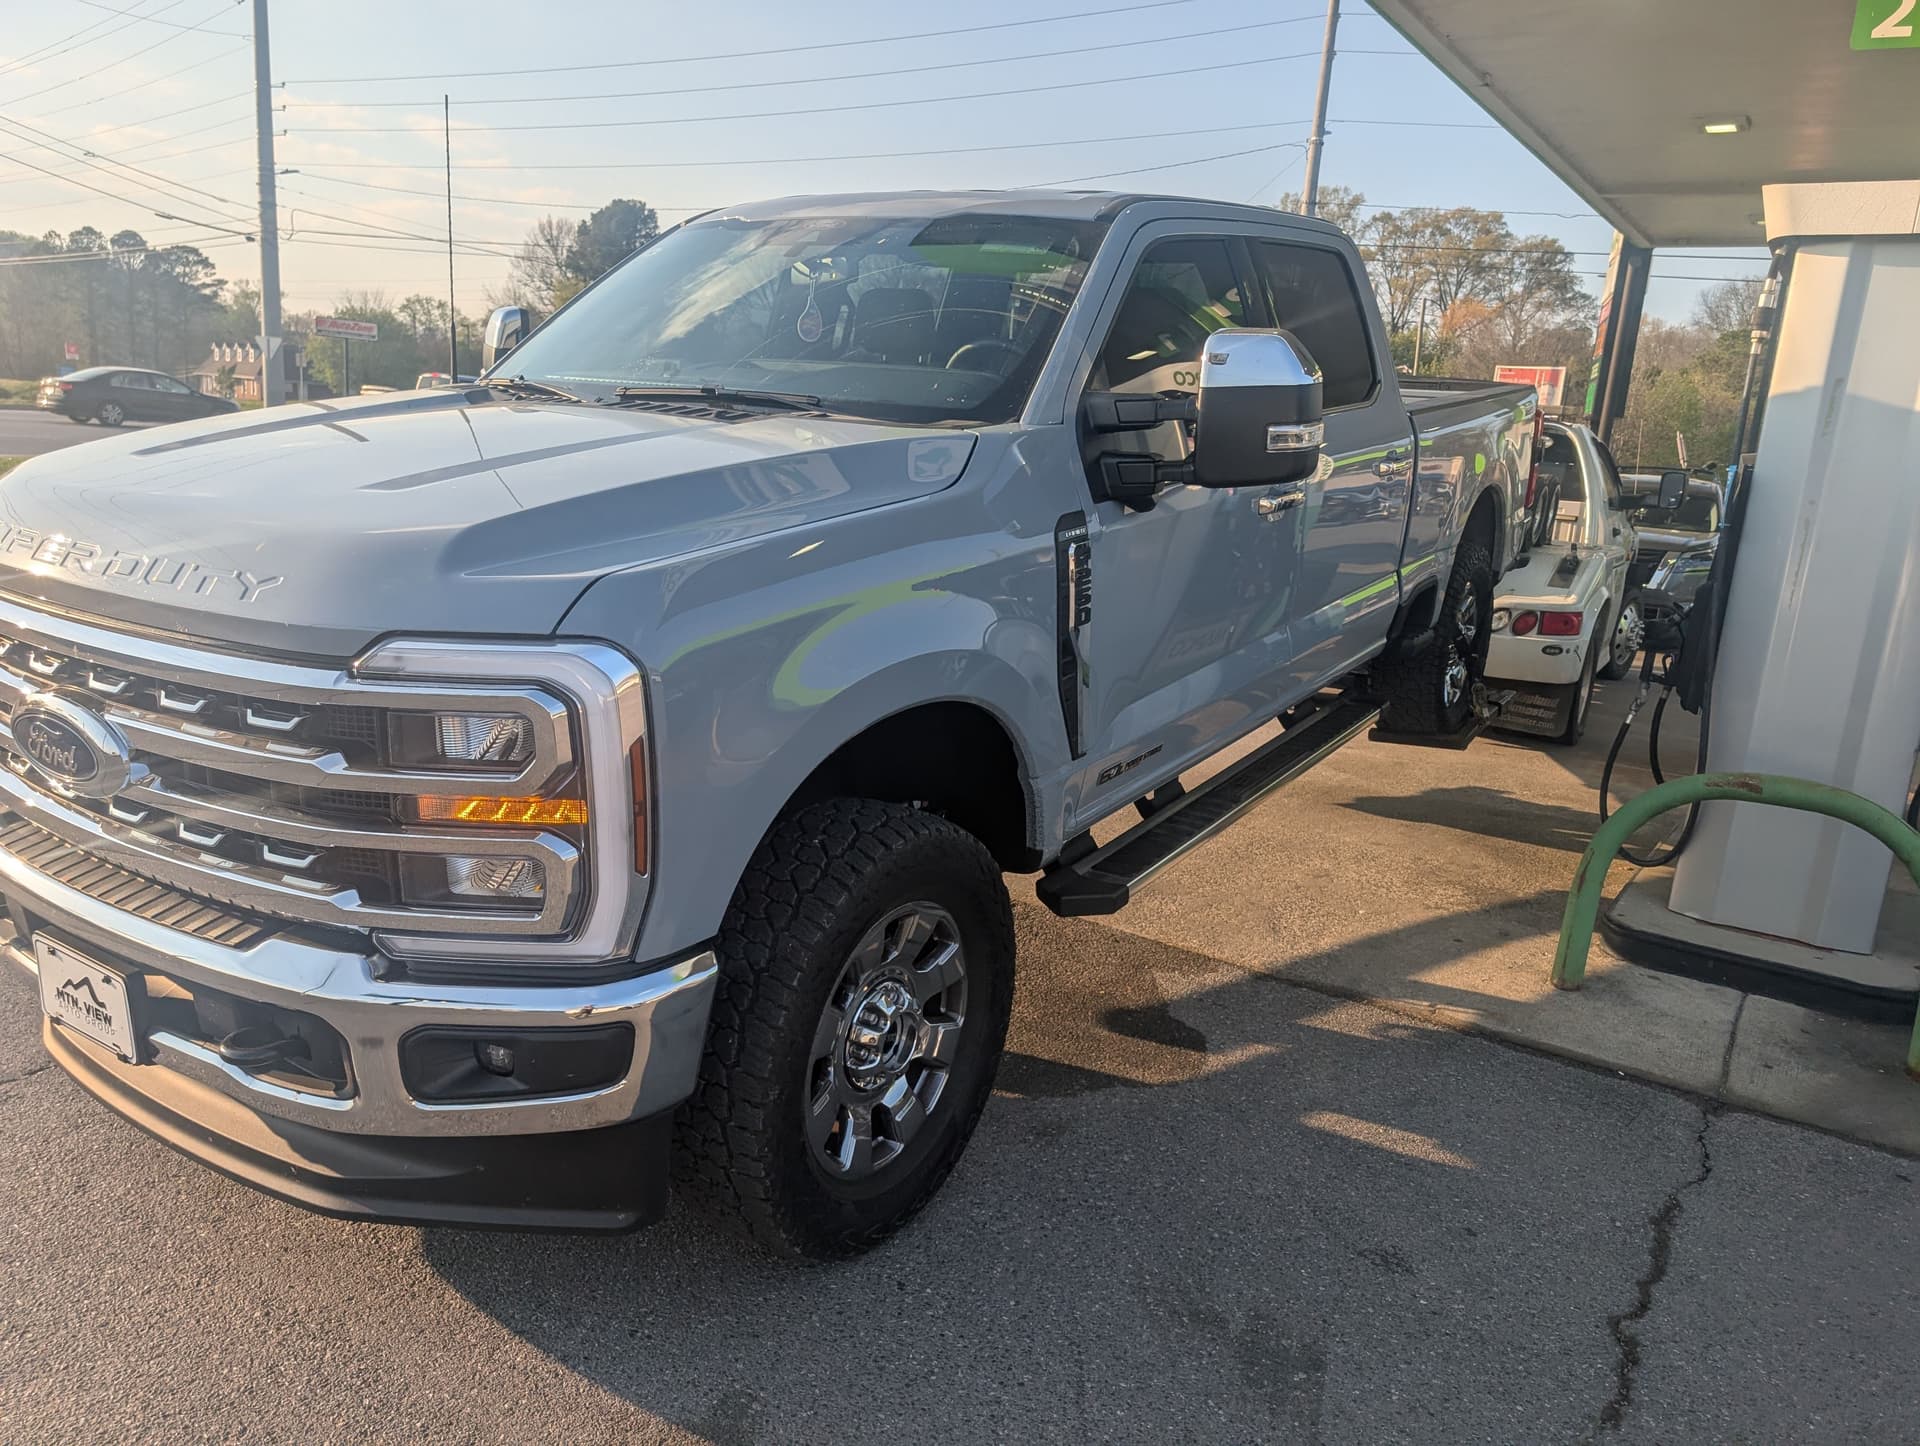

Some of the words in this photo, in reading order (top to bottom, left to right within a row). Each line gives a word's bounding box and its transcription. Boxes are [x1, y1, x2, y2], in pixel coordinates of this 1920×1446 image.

[1871, 0, 1916, 38] 2
[102, 550, 284, 602] DUTY
[28, 721, 78, 772] Ford
[56, 986, 82, 1011] MTN.
[83, 1001, 112, 1026] VIEW
